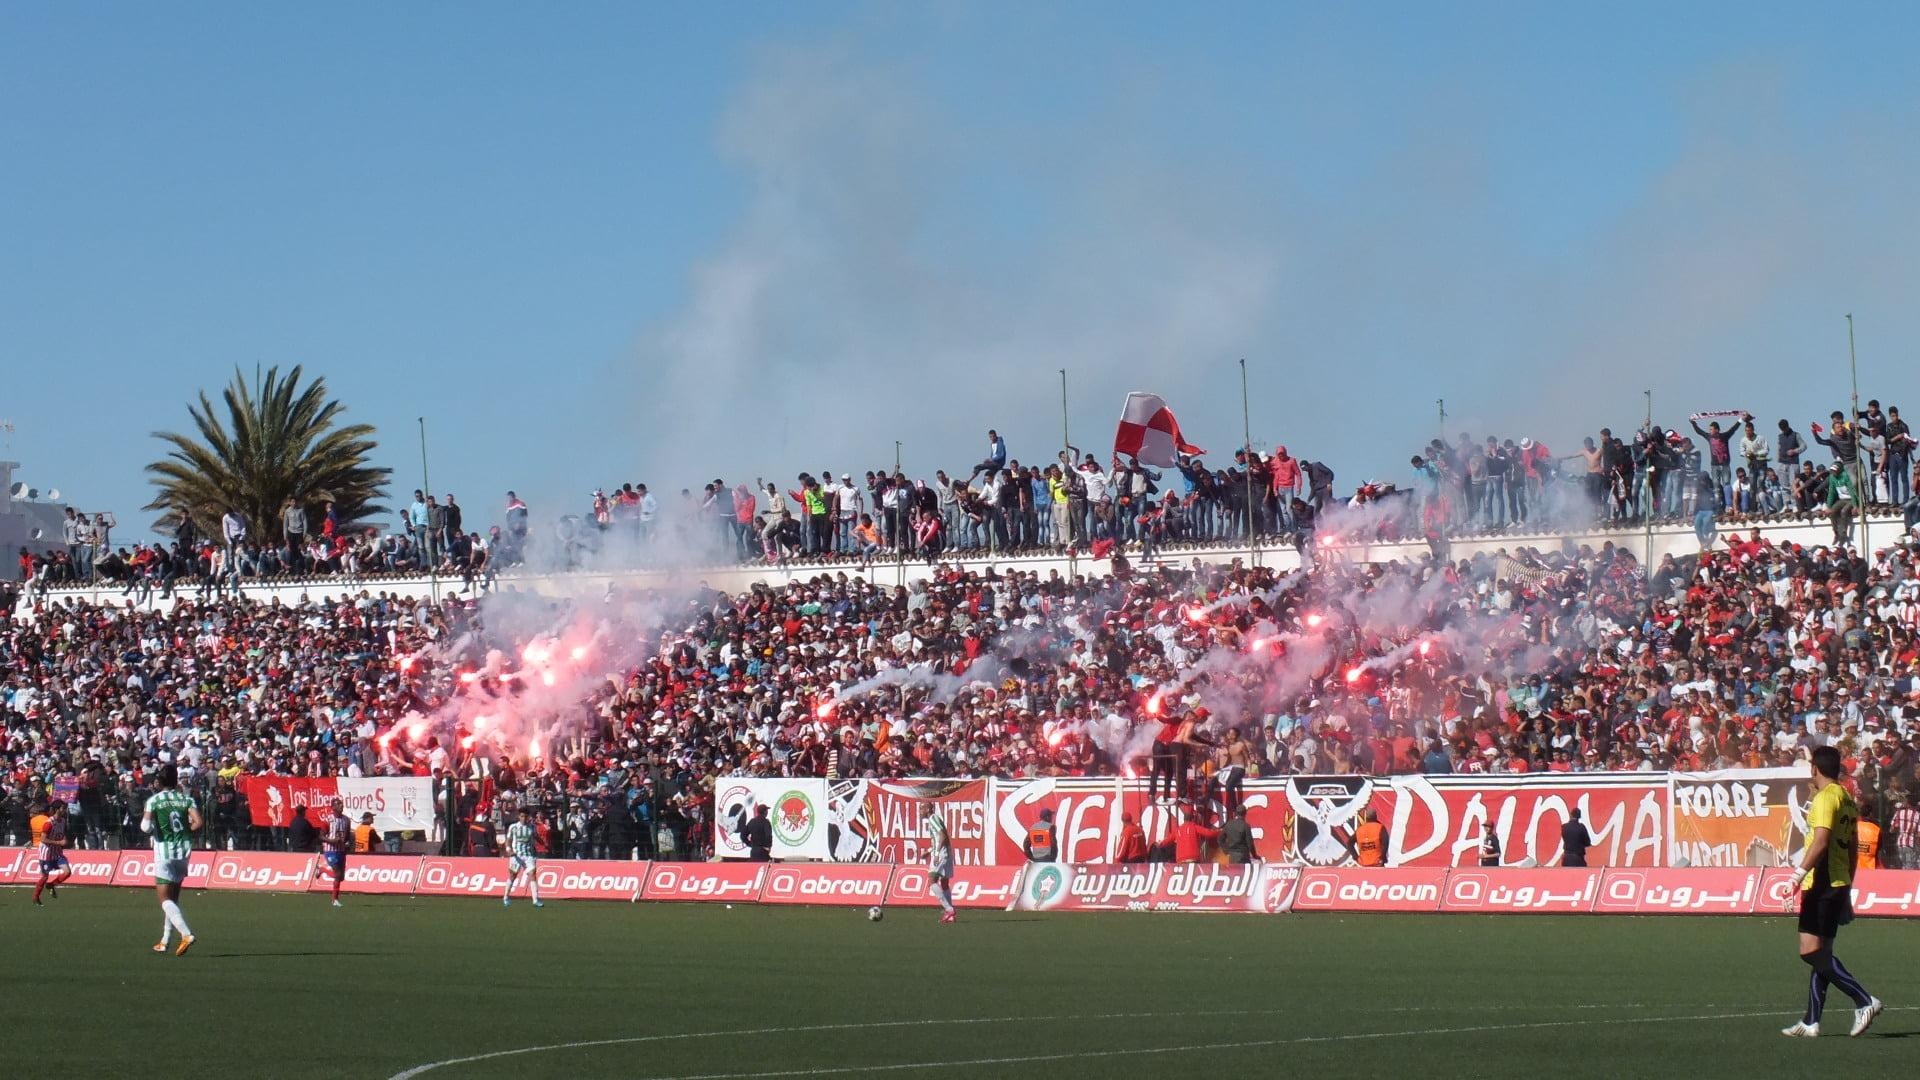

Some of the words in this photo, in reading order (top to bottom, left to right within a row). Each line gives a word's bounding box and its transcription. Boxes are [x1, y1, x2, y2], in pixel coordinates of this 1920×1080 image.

[1675, 781, 1770, 818] TORRE
[169, 810, 184, 833] 6
[49, 861, 113, 877] roun
[562, 872, 639, 891] abroun
[800, 876, 882, 896] abroun
[1339, 880, 1437, 901] abroun
